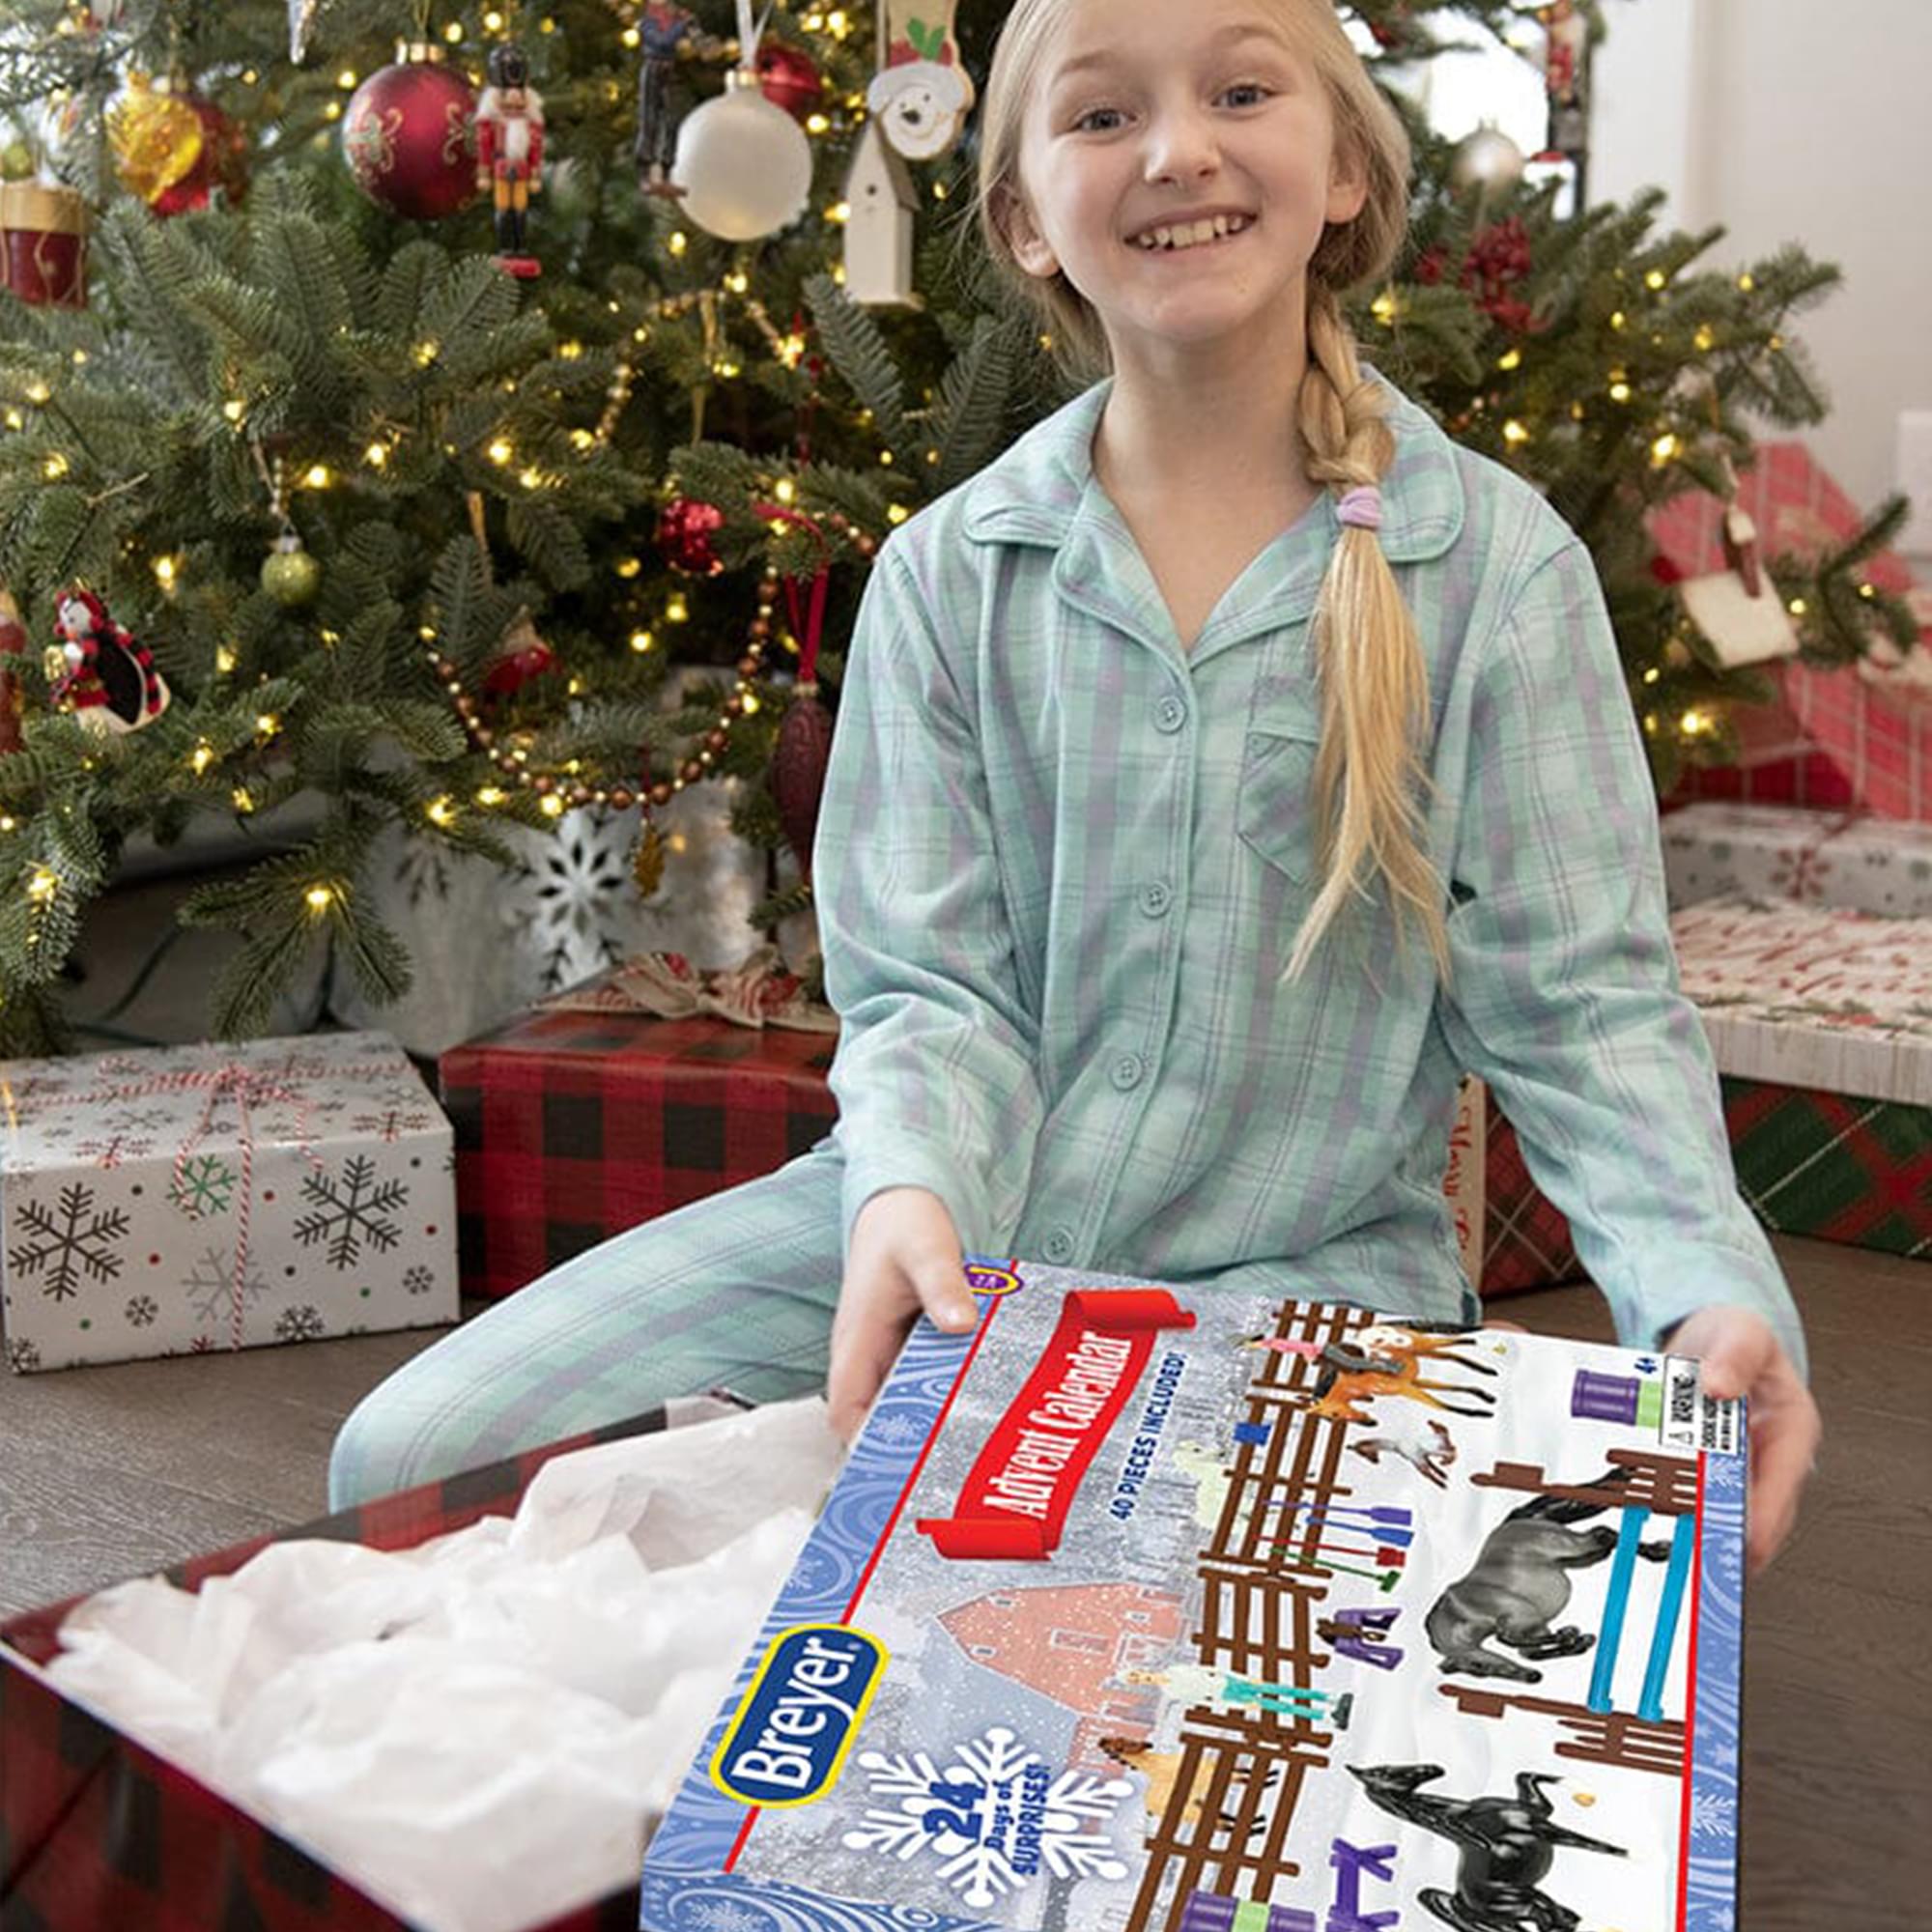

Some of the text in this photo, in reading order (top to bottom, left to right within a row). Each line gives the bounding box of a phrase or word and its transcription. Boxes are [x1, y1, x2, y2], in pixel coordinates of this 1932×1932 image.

[983, 1330, 1132, 1520] Advent Calendar
[1110, 1351, 1186, 1520] 40 PIECES INCLUDED!
[731, 1637, 856, 1789] Breyer
[923, 1781, 986, 1839] 24
[984, 1779, 1014, 1850] Days of
[1010, 1764, 1051, 1876] SURPRISES!
